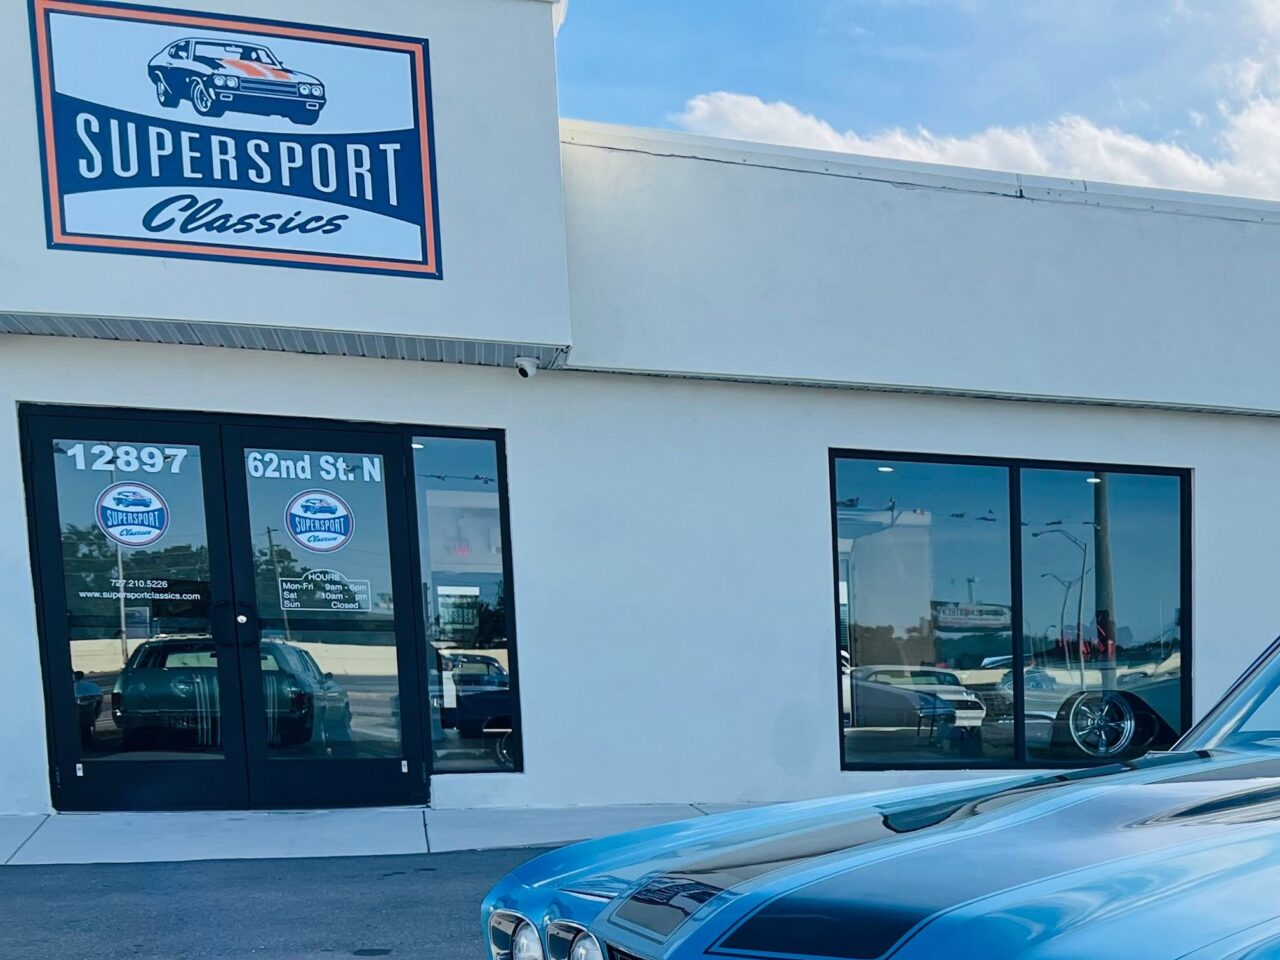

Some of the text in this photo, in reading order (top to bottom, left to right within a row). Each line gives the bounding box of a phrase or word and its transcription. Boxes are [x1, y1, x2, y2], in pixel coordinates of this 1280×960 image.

[76, 112, 401, 206] SUPERSPORT
[142, 194, 349, 234] Classics
[67, 443, 187, 473] 12897
[247, 452, 381, 482] 62nd St. N
[106, 509, 160, 527] SUPERSPORT
[295, 517, 345, 534] SUPERSPORT
[110, 579, 168, 588] 727.210.5226
[308, 573, 340, 581] HOURS
[282, 582, 314, 590] Mon-Fri
[325, 583, 343, 591] 9am
[78, 591, 201, 600] www.supersportclassics.com
[283, 591, 298, 599] Sat
[283, 600, 359, 609] Sun Closed
